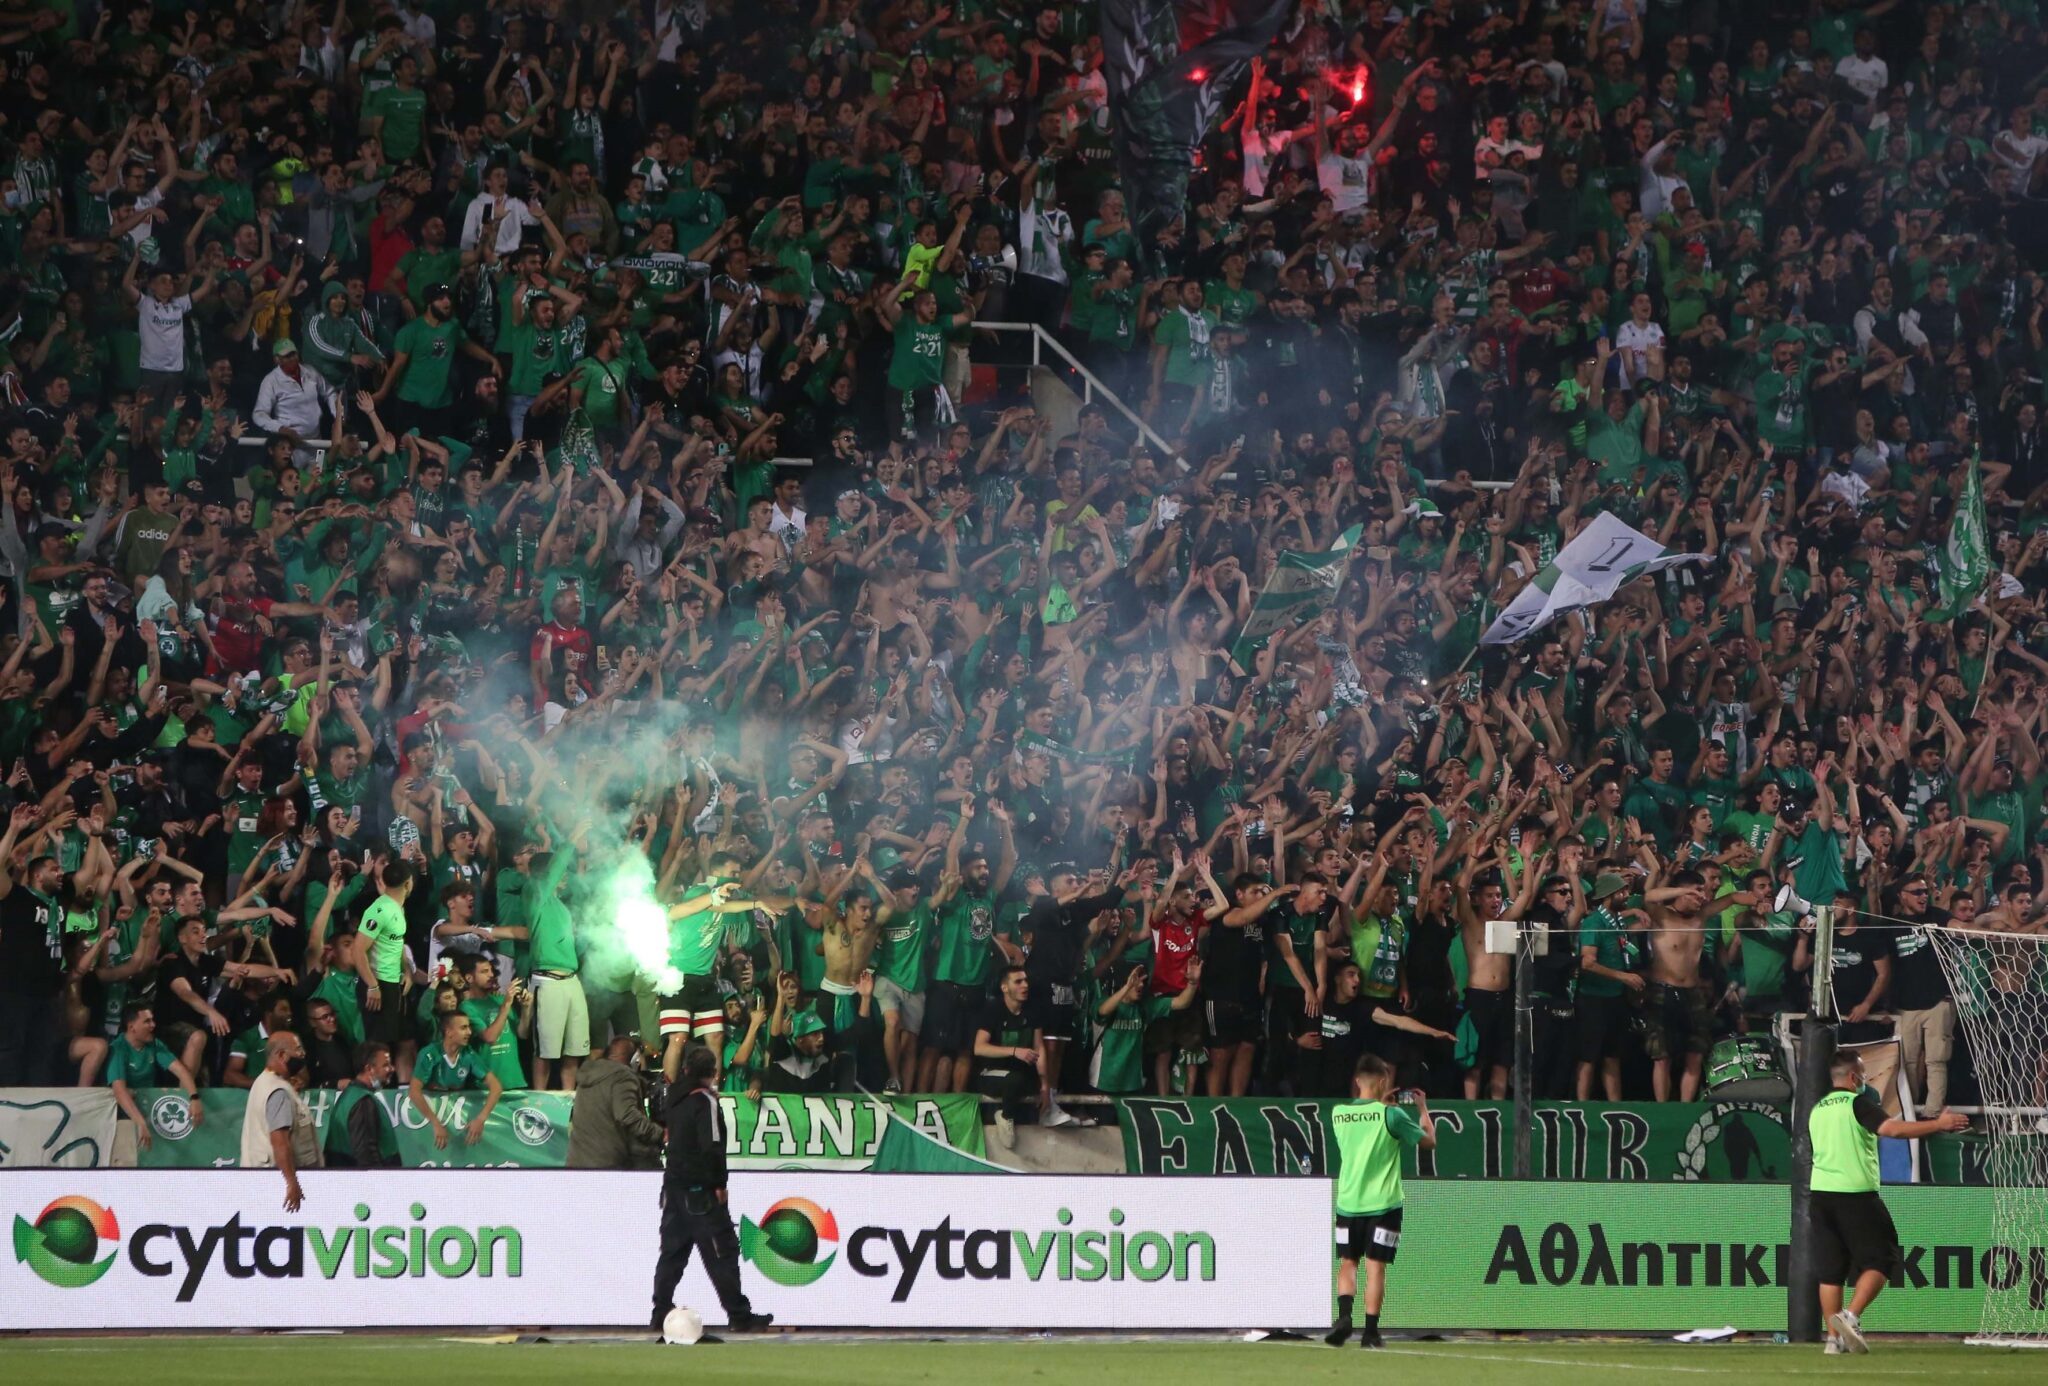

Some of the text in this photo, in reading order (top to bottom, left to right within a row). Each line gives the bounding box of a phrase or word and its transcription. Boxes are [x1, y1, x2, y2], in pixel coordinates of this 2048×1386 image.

[137, 528, 169, 542] adida
[34, 905, 65, 924] 198
[1121, 1097, 1327, 1174] FAN
[1333, 1111, 1381, 1126] macron
[129, 1202, 523, 1302] cytavision
[847, 1207, 1216, 1302] cytavision
